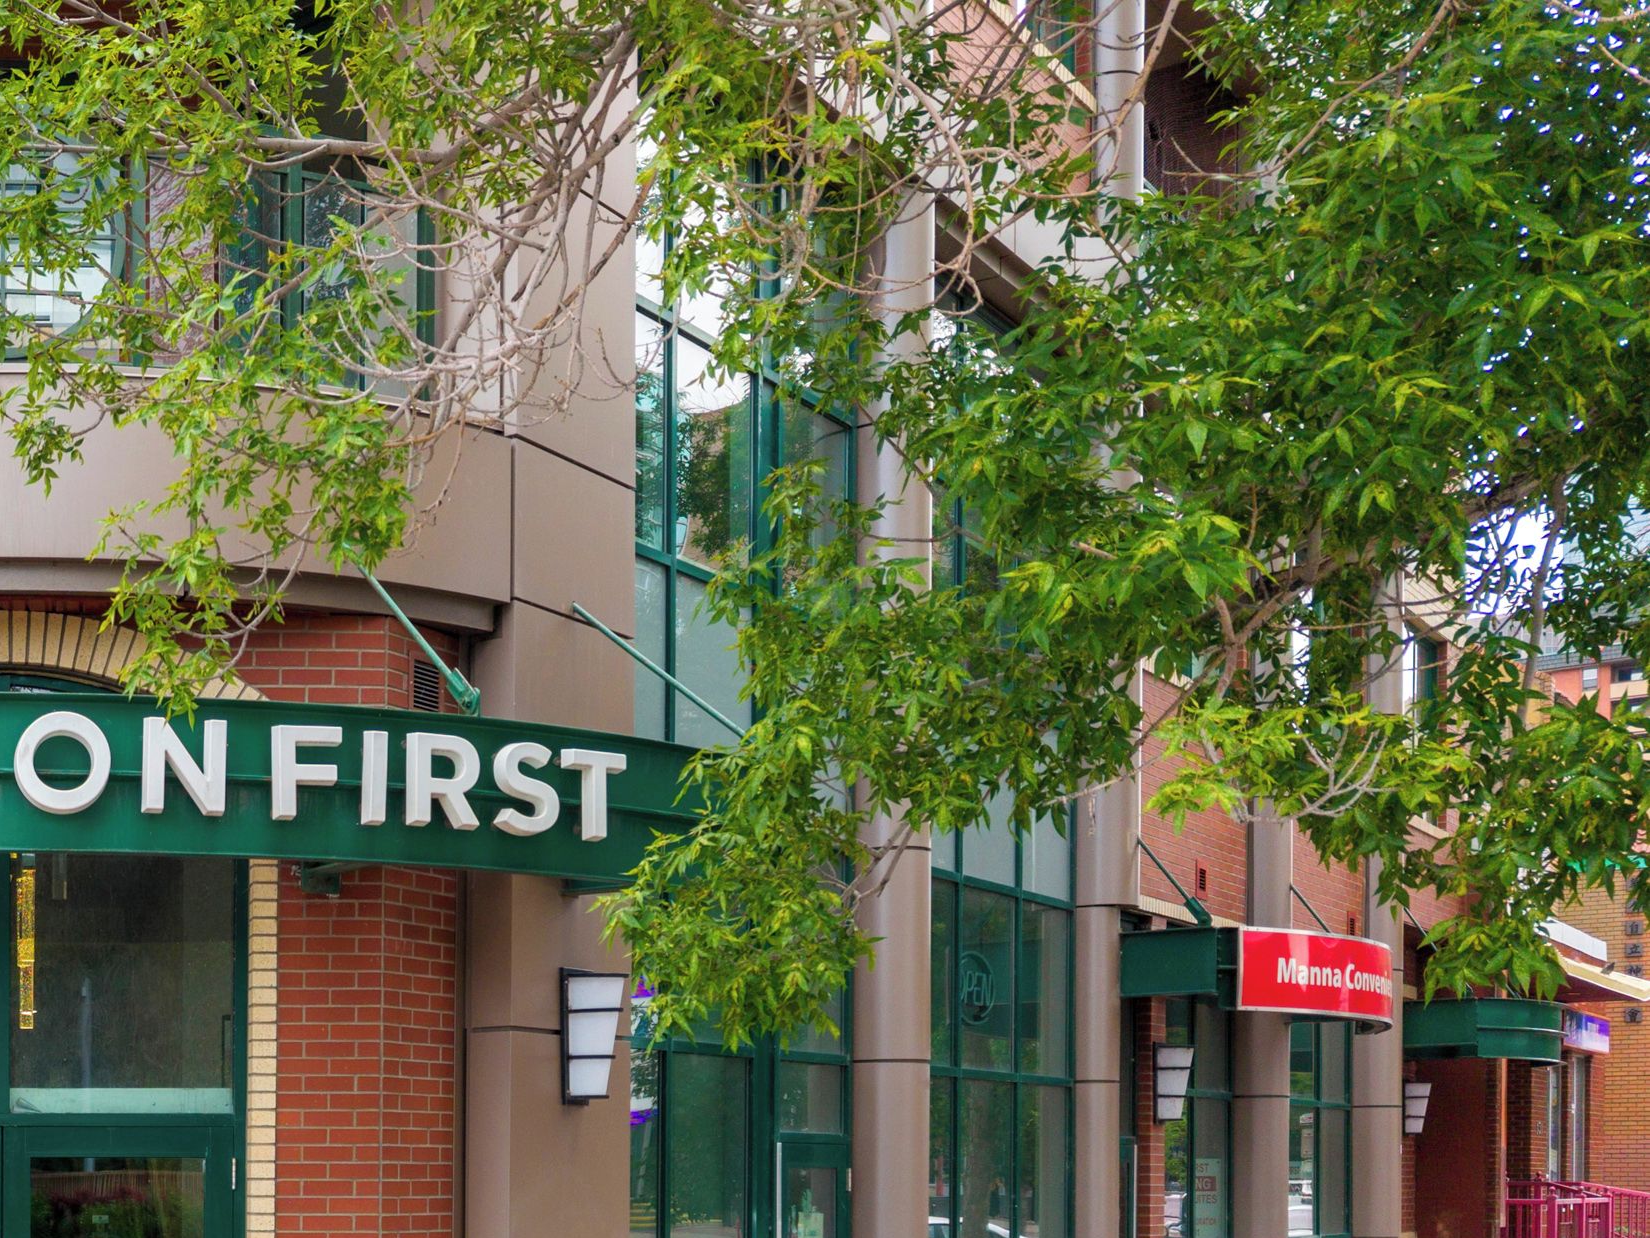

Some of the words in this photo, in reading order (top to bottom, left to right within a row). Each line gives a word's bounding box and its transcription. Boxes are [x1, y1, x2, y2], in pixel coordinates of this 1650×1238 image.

[13, 711, 229, 817] ON
[271, 725, 627, 842] FIRST
[1276, 957, 1342, 988] Manna
